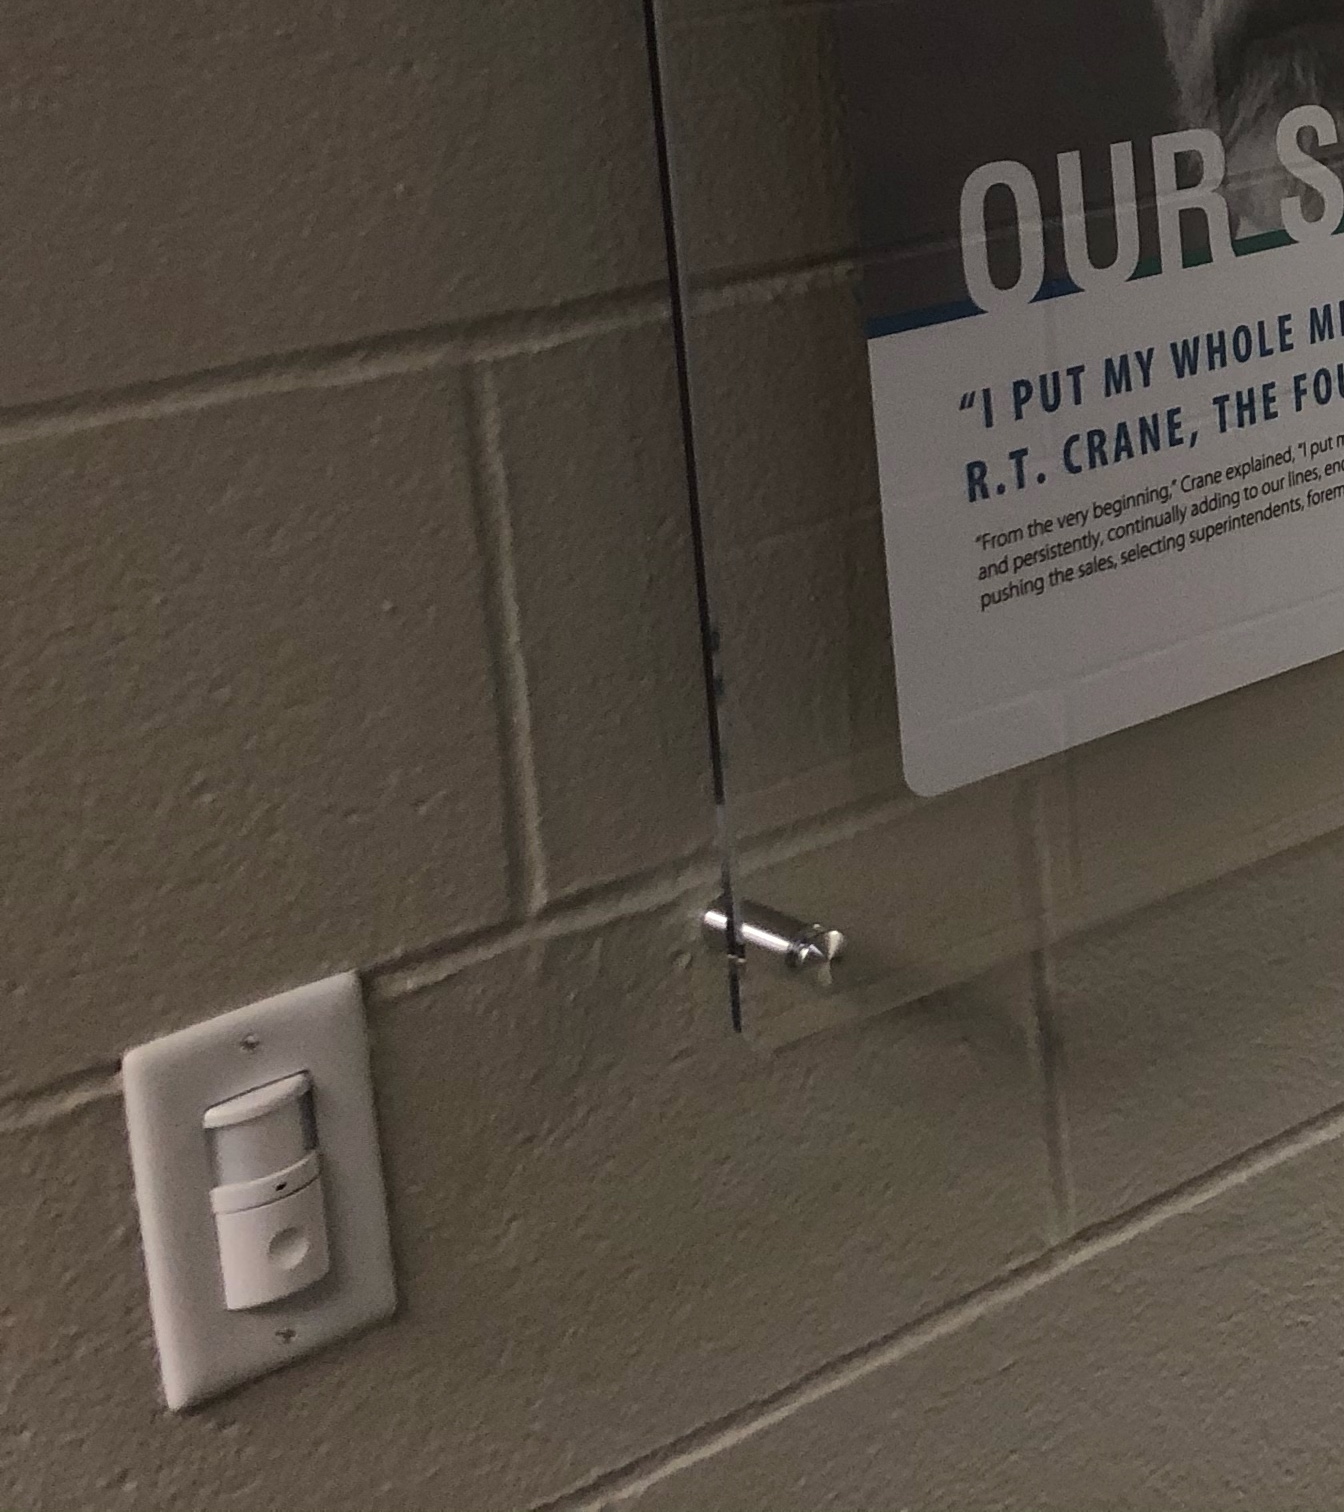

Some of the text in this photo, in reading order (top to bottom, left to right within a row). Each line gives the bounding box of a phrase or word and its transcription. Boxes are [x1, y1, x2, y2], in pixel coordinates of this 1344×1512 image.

[959, 127, 1240, 315] OUR
[958, 387, 994, 428] "I
[1012, 364, 1085, 421] PUT
[1104, 347, 1154, 398] MY
[1169, 313, 1294, 379] WHOLE
[965, 447, 1046, 503] R.T.
[1062, 406, 1198, 475] CRANE,
[1212, 381, 1278, 434] THE
[1026, 518, 1053, 538] the
[1056, 509, 1089, 529] very
[1180, 470, 1222, 493] Crane
[1225, 445, 1295, 480] explained,
[1310, 436, 1333, 460] put
[977, 554, 1009, 581] and
[1012, 530, 1104, 574] persistently,
[1106, 504, 1187, 542] continually
[1190, 490, 1240, 517] adding
[1243, 485, 1258, 501] to
[1261, 476, 1285, 496] our
[1287, 467, 1322, 487] lines,
[980, 576, 1045, 612] pushing
[1048, 567, 1075, 587] the
[1078, 555, 1118, 579] sales,
[1120, 533, 1185, 565] selecting
[1188, 497, 1304, 544] superintendents,
